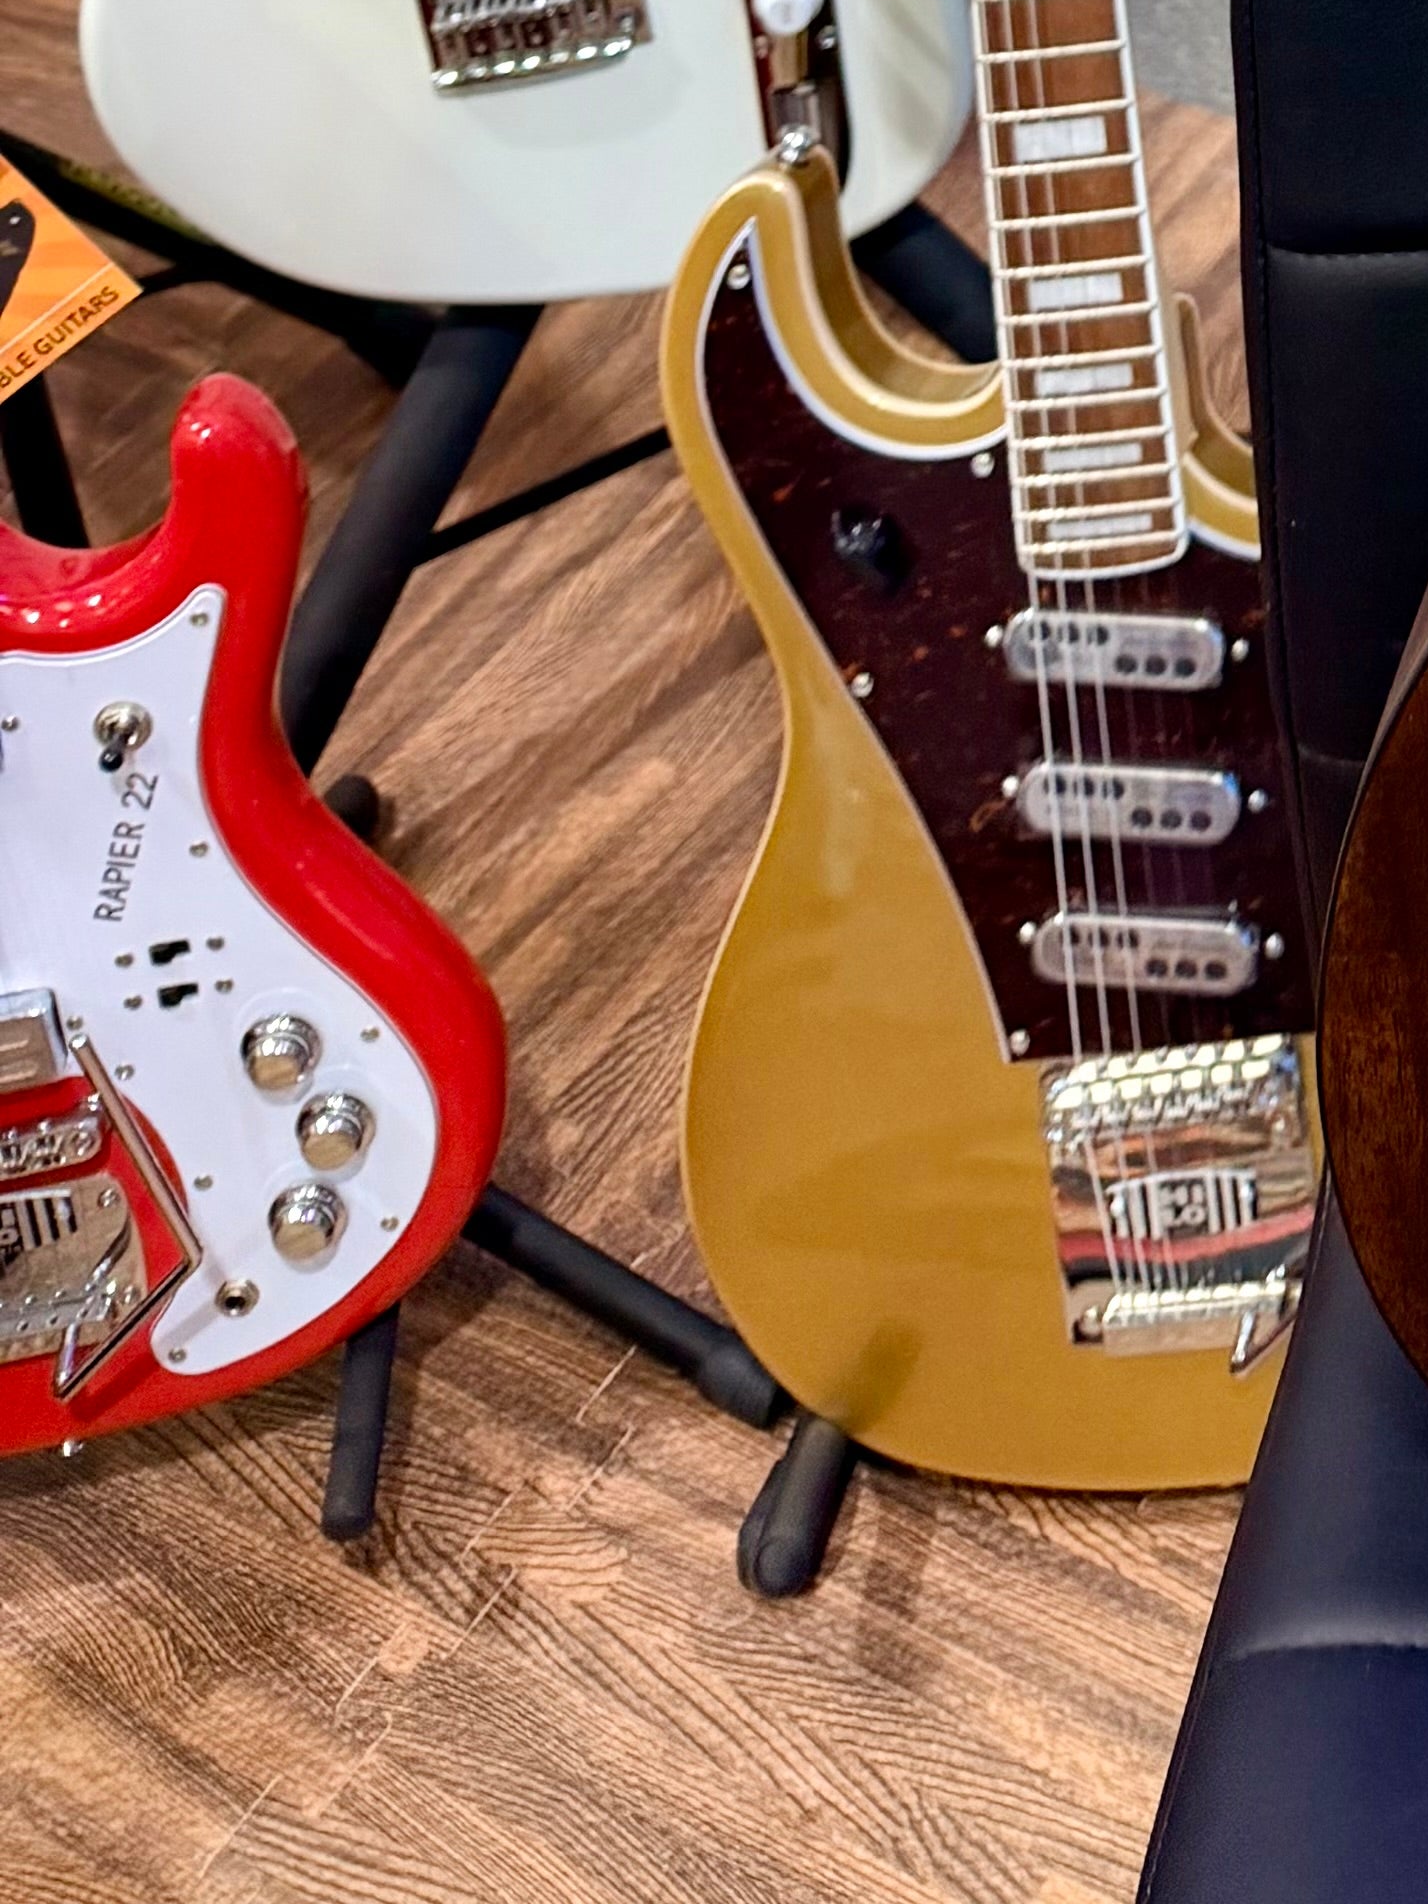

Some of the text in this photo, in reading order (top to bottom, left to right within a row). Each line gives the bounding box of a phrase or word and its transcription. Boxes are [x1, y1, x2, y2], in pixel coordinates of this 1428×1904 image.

[33, 286, 119, 355] GUITARS
[94, 772, 159, 922] RAPIER 22
